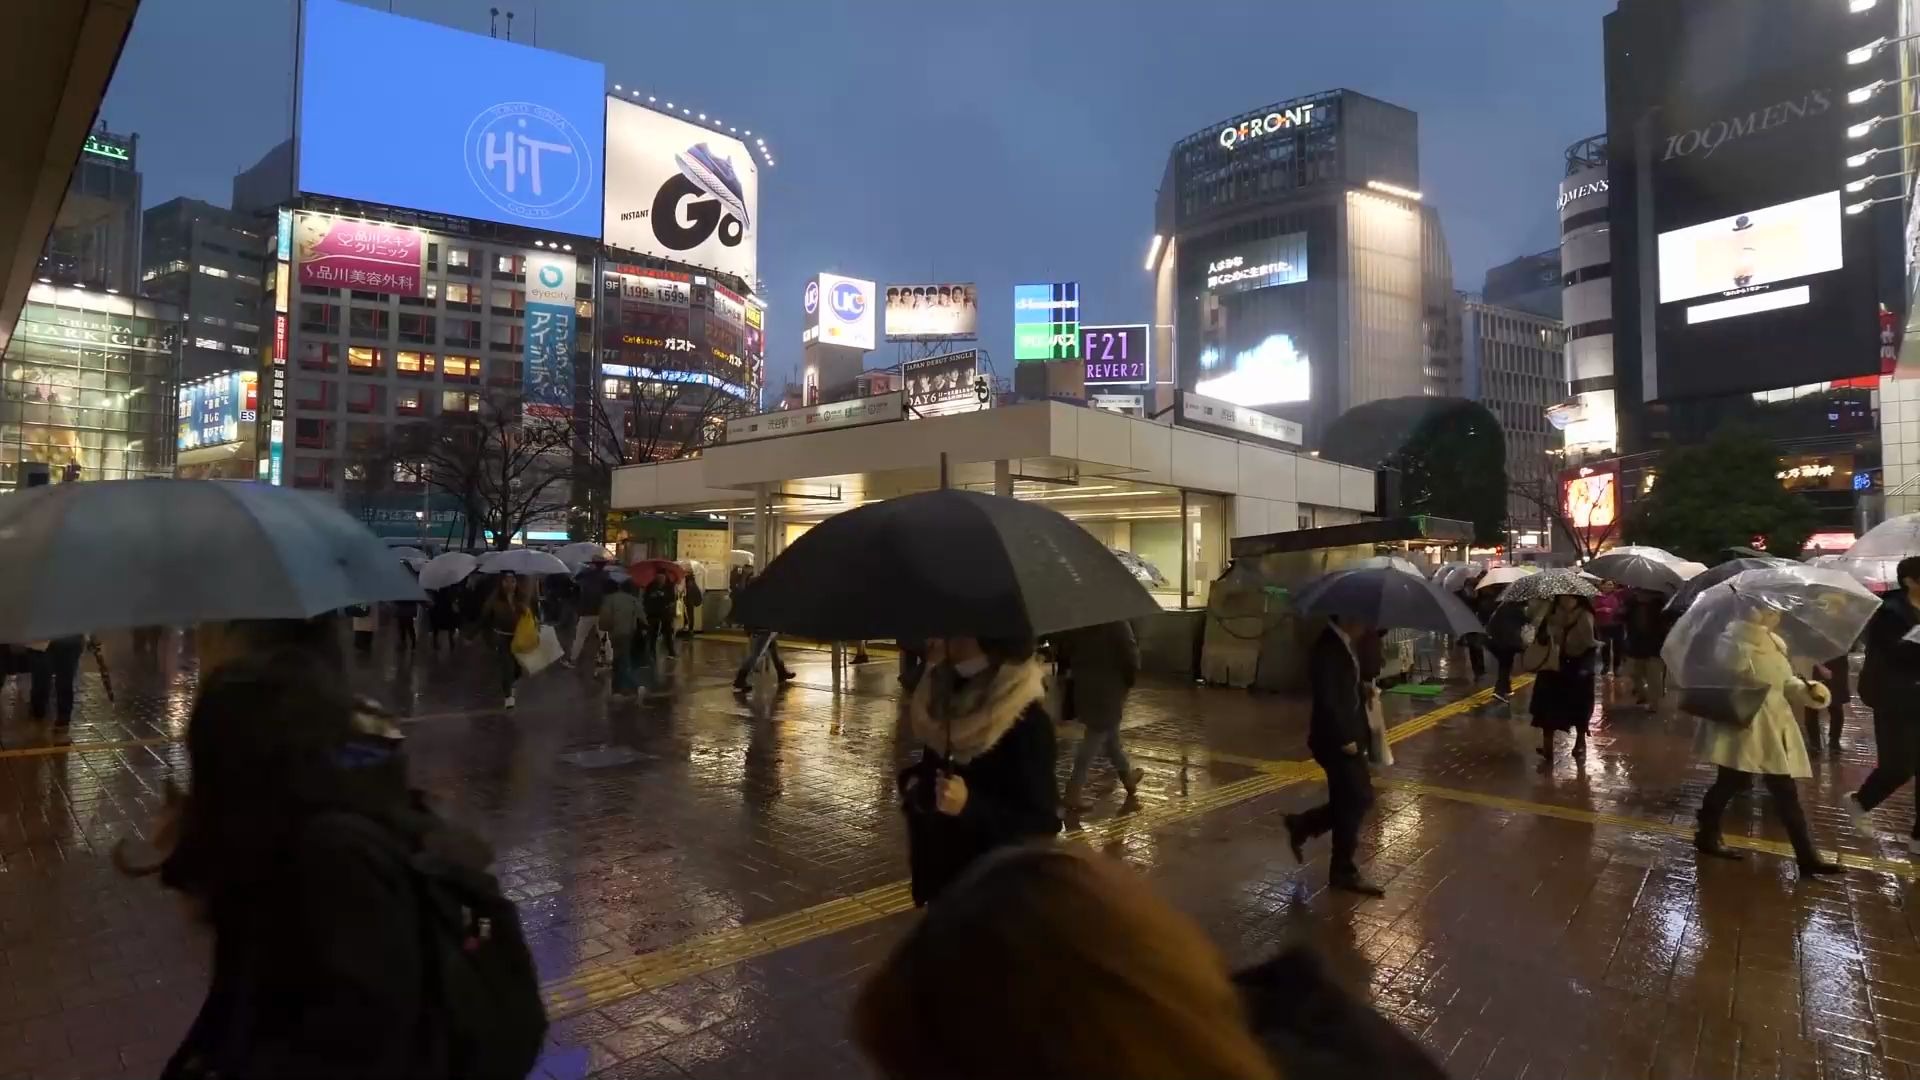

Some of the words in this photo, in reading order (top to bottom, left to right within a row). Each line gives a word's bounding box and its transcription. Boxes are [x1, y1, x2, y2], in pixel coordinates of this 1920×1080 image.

[1220, 104, 1314, 150] QFRONT
[620, 209, 649, 221] INSTANT
[355, 231, 416, 247] 品川スキン
[355, 243, 409, 258] クリニック
[317, 267, 414, 289] 品川美容外科
[605, 280, 619, 290] 9F
[531, 288, 570, 301] eyecity
[832, 289, 864, 315] UC
[111, 334, 173, 350] CITY
[665, 337, 696, 352] ガスト
[926, 357, 948, 366] DEBUT
[949, 351, 974, 361] SINGLE
